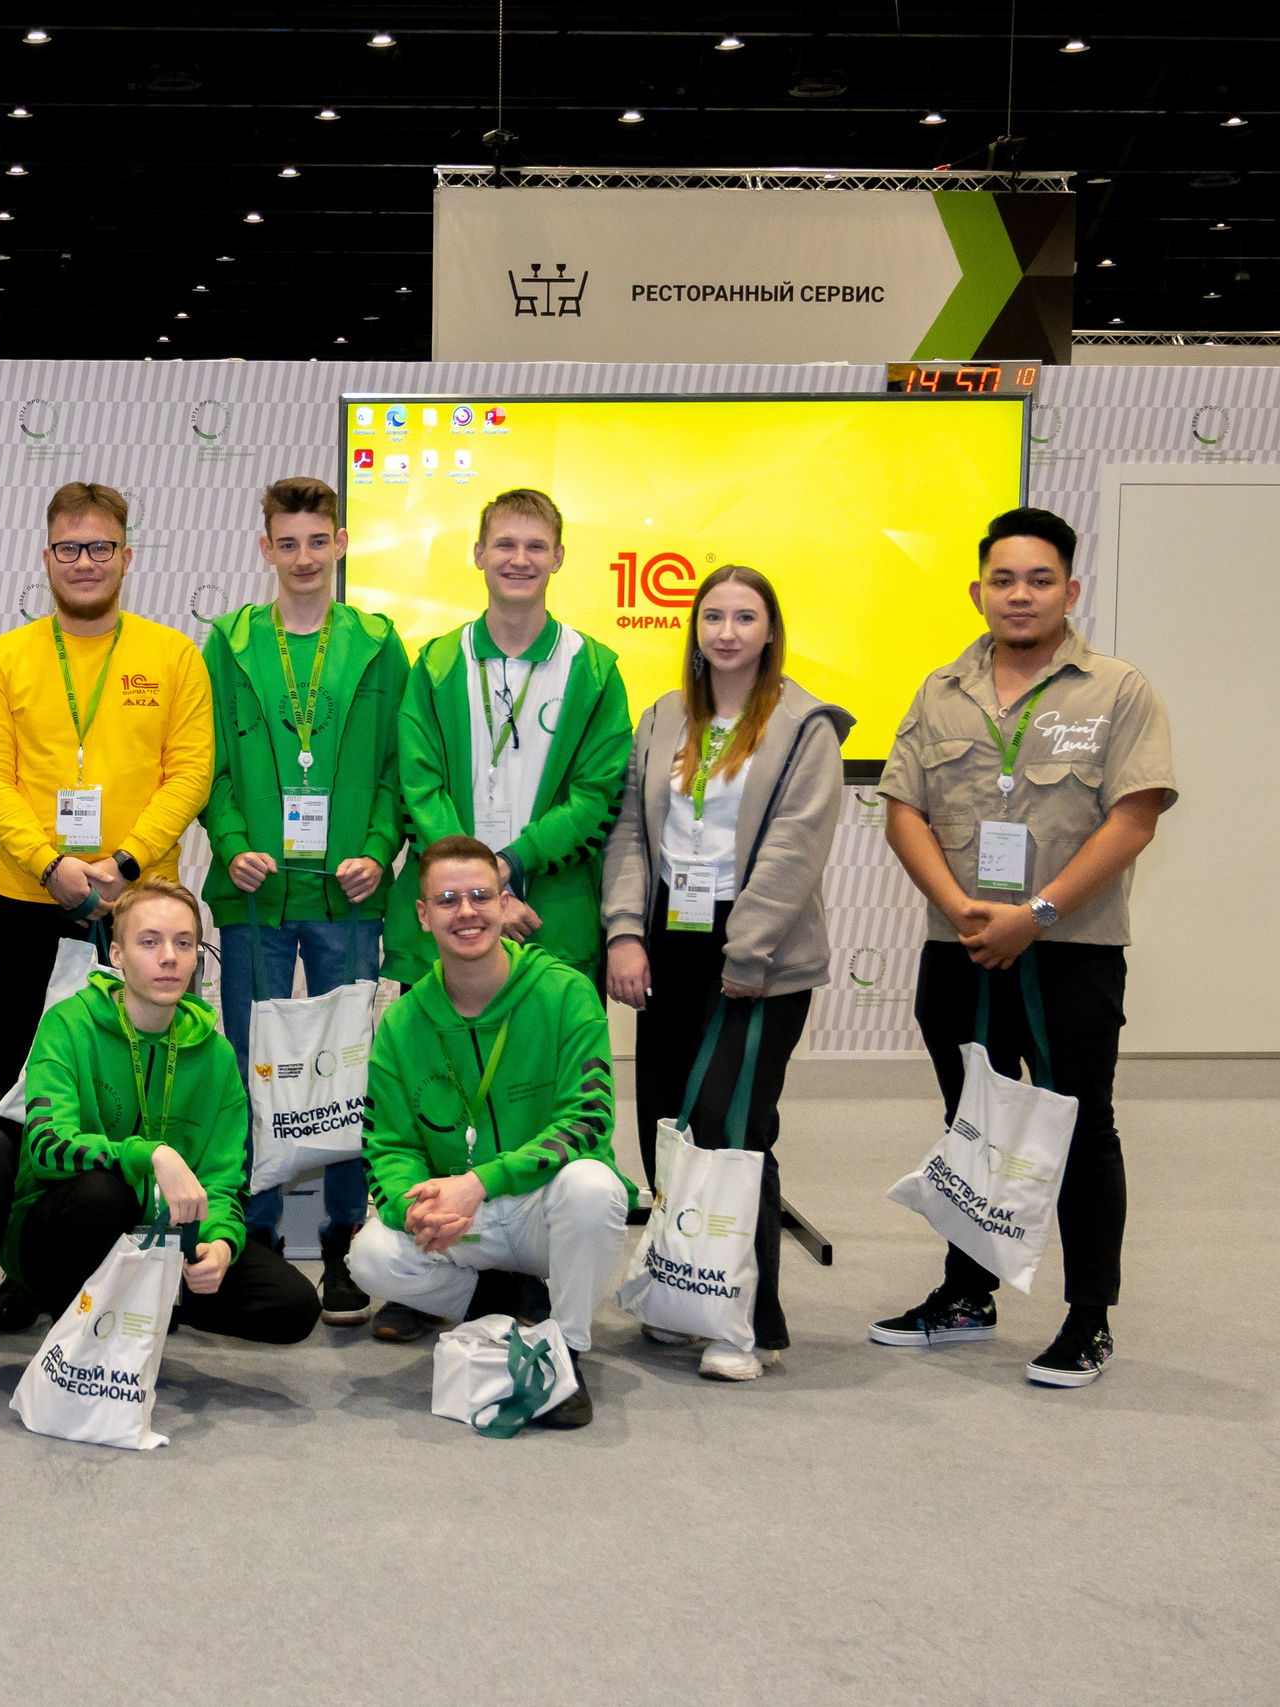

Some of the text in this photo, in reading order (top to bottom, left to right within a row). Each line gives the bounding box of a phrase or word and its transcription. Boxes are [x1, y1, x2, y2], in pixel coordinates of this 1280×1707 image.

[631, 280, 885, 303] РЕСТОРАННЫЙ СЕРВИС
[1015, 367, 1036, 386] 10
[610, 552, 699, 608] 1С
[616, 616, 681, 628] ФИРМА
[279, 694, 288, 715] 2024
[273, 1101, 341, 1127] ДЕЙСТВУЙ
[274, 1111, 364, 1139] ПРОФЕССИО
[929, 1155, 988, 1212] ДЕЙСТВУЙ
[988, 1205, 1015, 1222] КАК
[922, 1165, 1026, 1240] ПРОФЕССИОНАЛ!
[698, 1267, 726, 1283] КАК
[110, 1370, 140, 1387] КАК
